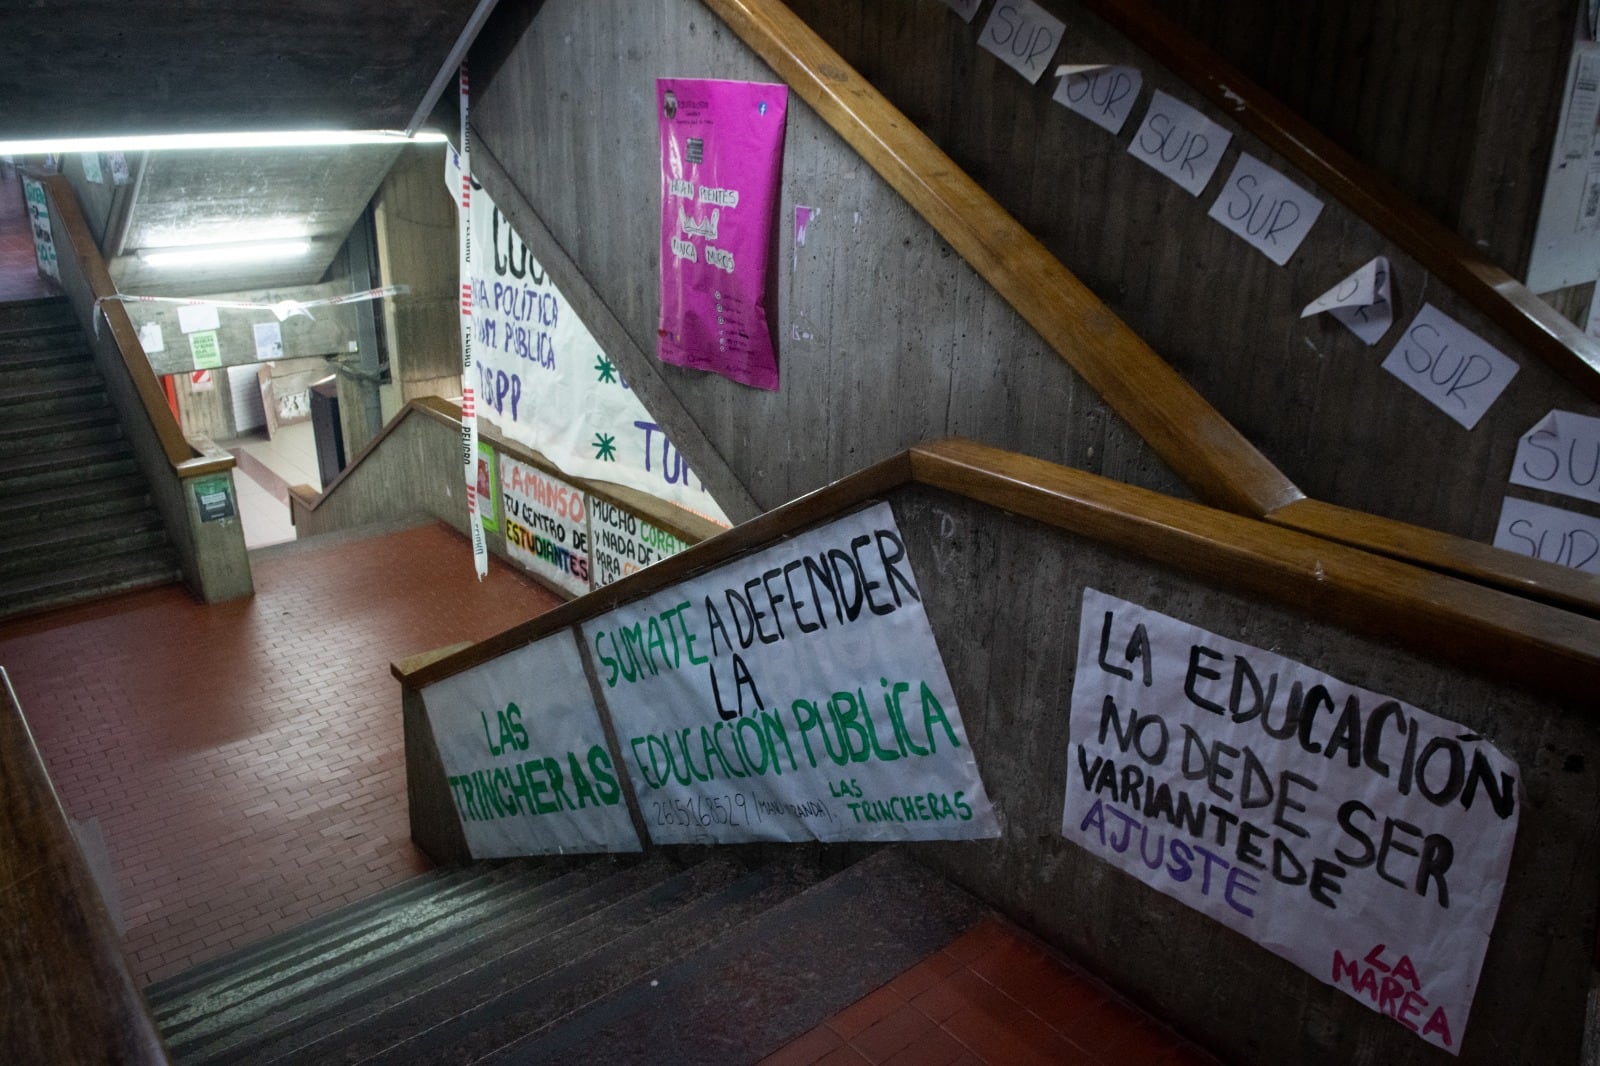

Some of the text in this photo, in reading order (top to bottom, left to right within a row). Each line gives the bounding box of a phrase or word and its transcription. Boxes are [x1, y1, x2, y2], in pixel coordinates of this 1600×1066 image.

[989, 6, 1053, 71] SUR
[1139, 112, 1209, 180] SUR
[1227, 174, 1300, 245] SUR
[1403, 323, 1492, 409] SUR
[1523, 430, 1600, 490] SU
[503, 493, 588, 554] TU CENTRO DE
[592, 497, 636, 536] MUCHO
[602, 529, 636, 560] NADA
[505, 518, 589, 583] ESTUDIANTES
[596, 549, 621, 577] PARA
[595, 600, 709, 687] SUMATE
[709, 652, 765, 721] LA
[1098, 611, 1515, 819] LA EDUCACIÓN
[481, 702, 529, 756] LAS
[448, 744, 620, 822] TRINCHERAS
[828, 778, 863, 798] LAS
[848, 791, 973, 823] TRINCHERAS
[1098, 696, 1169, 765] NO
[1334, 800, 1454, 908] SER
[1081, 800, 1260, 918] AJUSTE
[1332, 950, 1453, 1046] MAREA
[1364, 944, 1420, 991] LA
